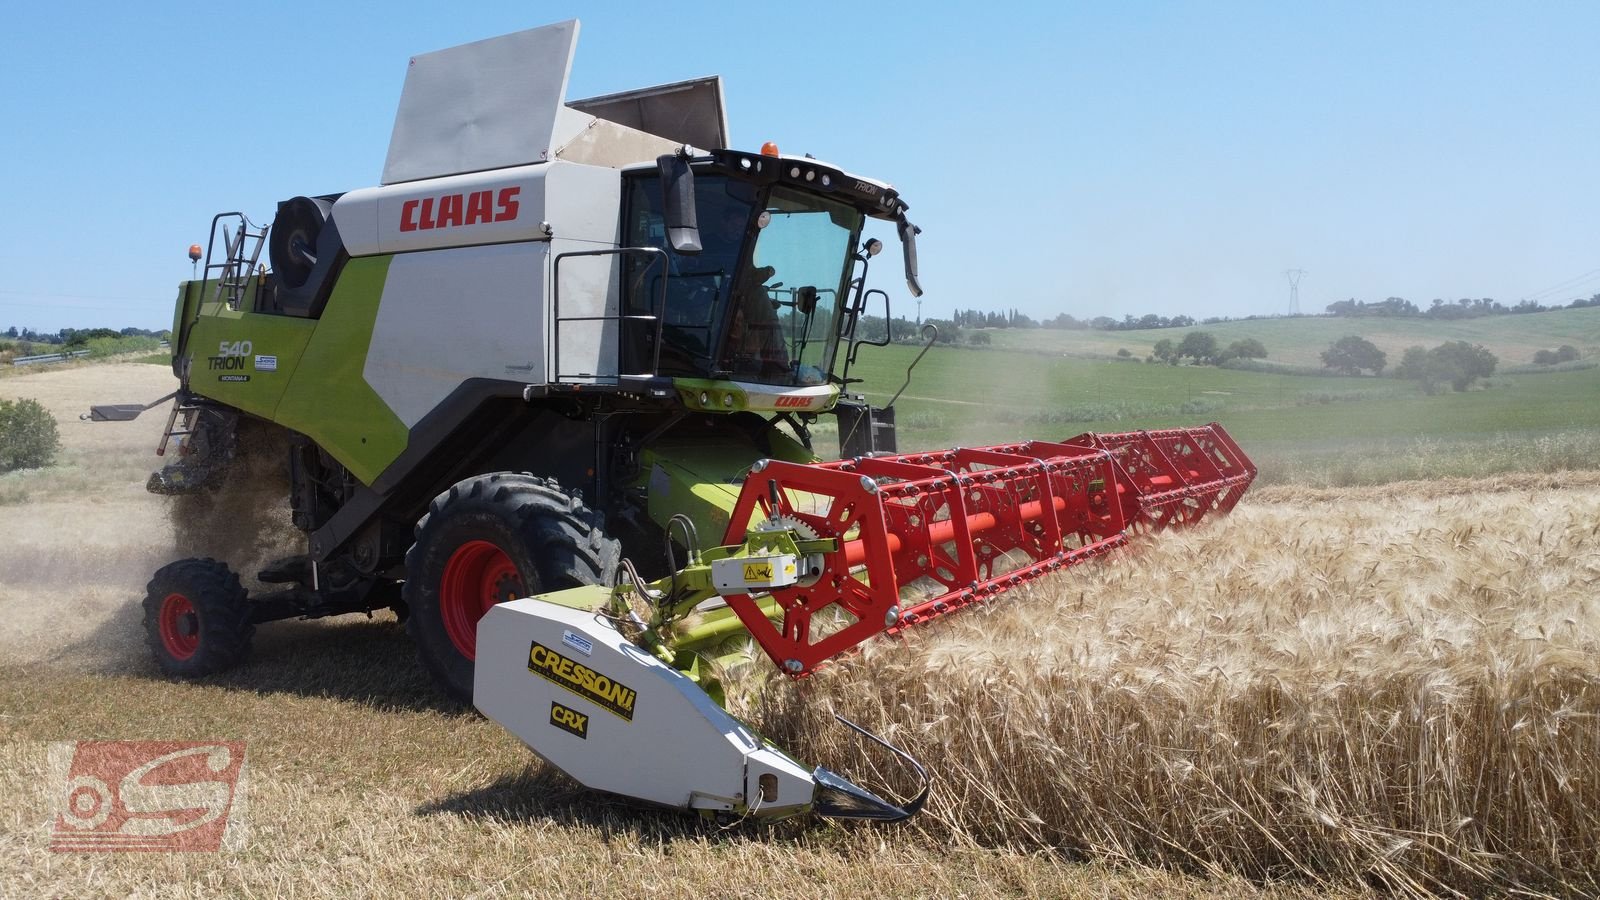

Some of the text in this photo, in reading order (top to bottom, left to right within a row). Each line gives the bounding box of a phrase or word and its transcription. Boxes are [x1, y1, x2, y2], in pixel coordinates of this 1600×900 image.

[854, 180, 878, 195] TRION
[399, 186, 521, 232] CLAAS
[217, 340, 252, 357] 540
[207, 356, 245, 370] TRION
[774, 395, 815, 408] CLAAS
[551, 705, 588, 732] CRX
